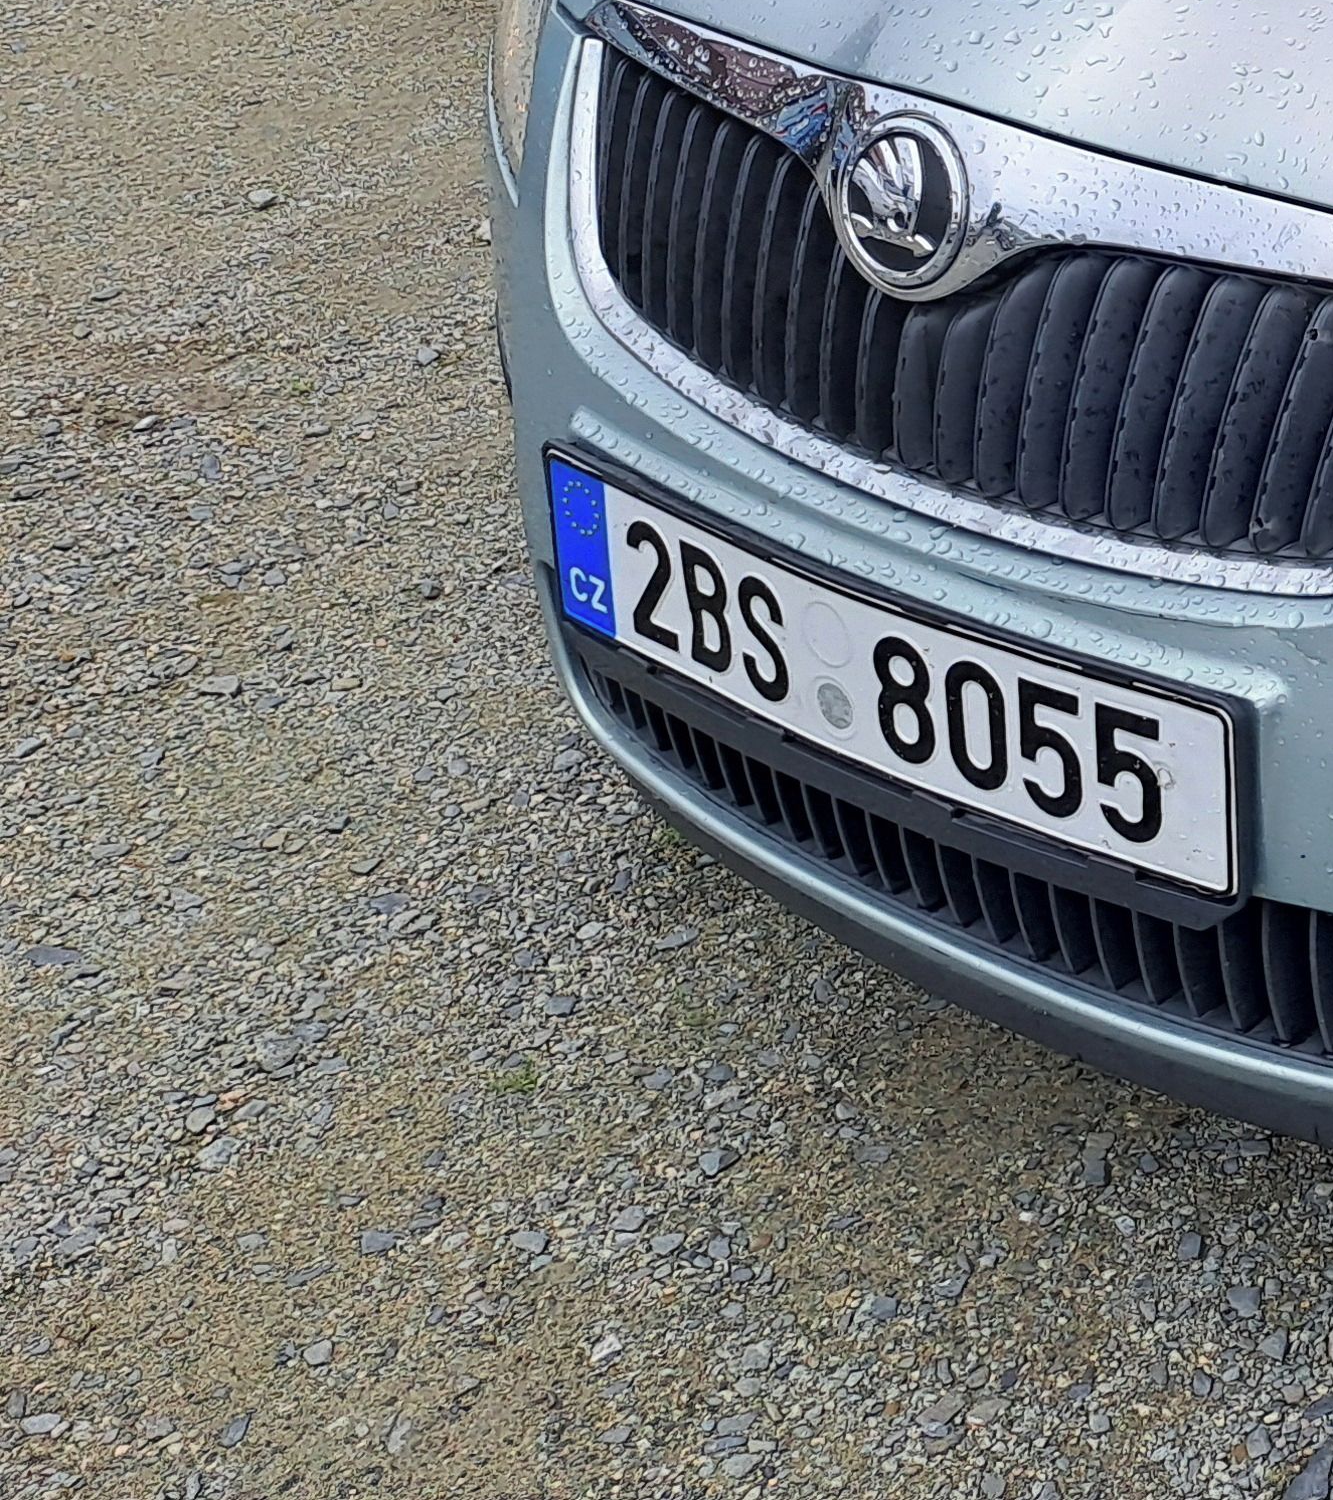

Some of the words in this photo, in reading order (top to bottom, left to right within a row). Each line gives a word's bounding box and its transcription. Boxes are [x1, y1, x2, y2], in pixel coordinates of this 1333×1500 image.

[569, 566, 608, 614] CZ
[626, 519, 790, 702] 2BS
[872, 635, 1162, 844] 8055
